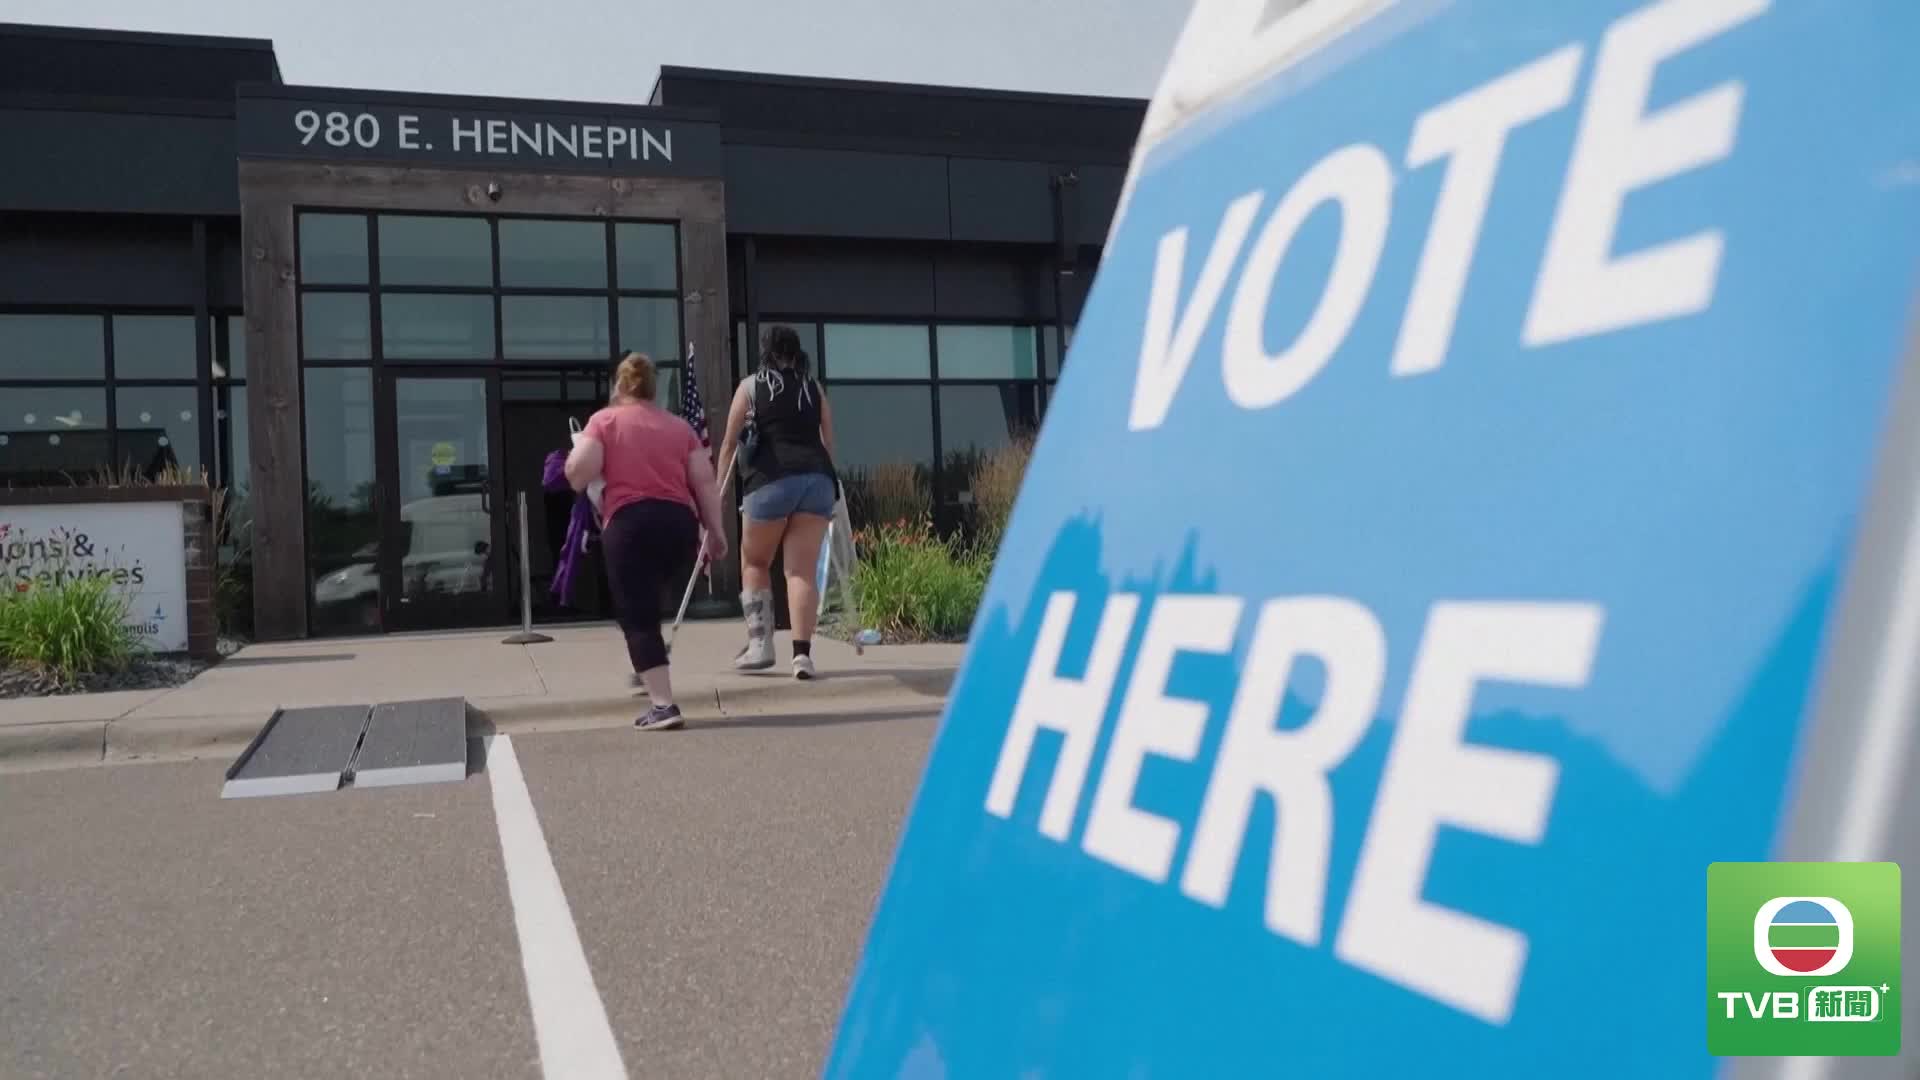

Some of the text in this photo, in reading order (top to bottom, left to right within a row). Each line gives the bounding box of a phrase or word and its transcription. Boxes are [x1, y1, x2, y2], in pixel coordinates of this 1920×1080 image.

[294, 110, 672, 162] 980 E. HENNEPIN
[1128, 0, 1774, 431] VOTE
[985, 590, 1604, 1027] HERE
